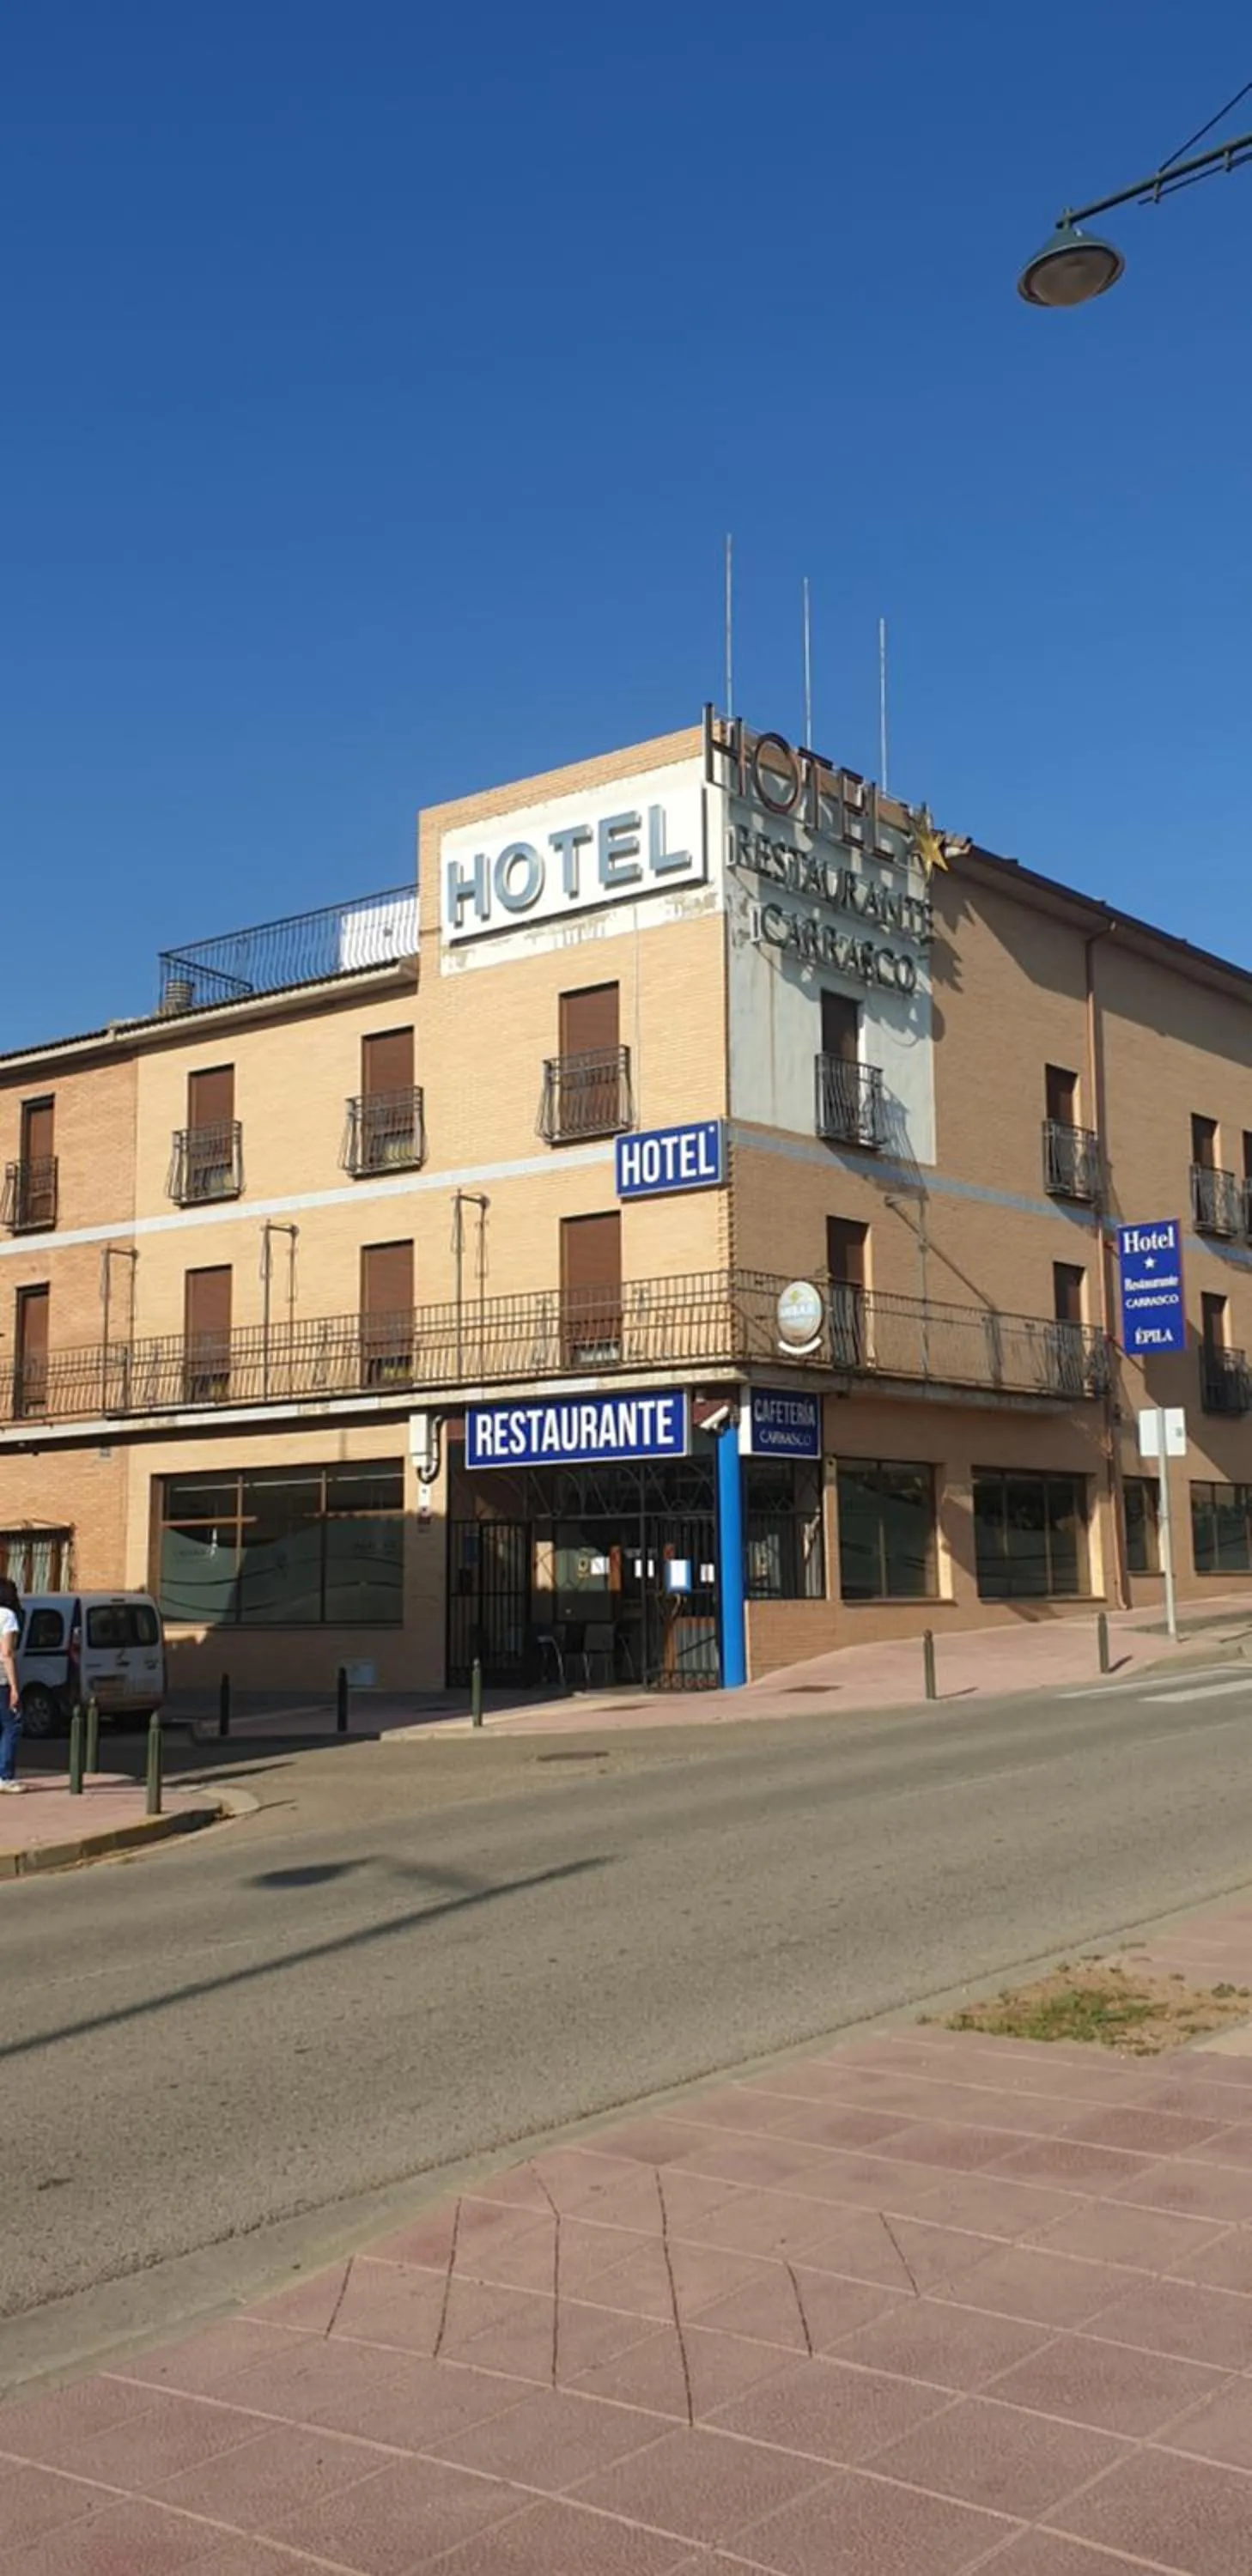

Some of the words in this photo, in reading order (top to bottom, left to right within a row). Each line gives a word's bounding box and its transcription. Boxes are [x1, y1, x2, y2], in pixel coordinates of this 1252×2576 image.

[702, 702, 895, 861] HOTEL
[447, 804, 691, 928] HOTEL
[726, 824, 933, 944] RESTAURANTE
[751, 902, 918, 997] CARRASCO
[621, 1130, 716, 1188] HOTEL
[1122, 1225, 1175, 1253] Hotel
[1126, 1293, 1179, 1309] CARRASCO
[1134, 1327, 1173, 1345] ÉPILA
[475, 1398, 675, 1457] RESTAURANTE
